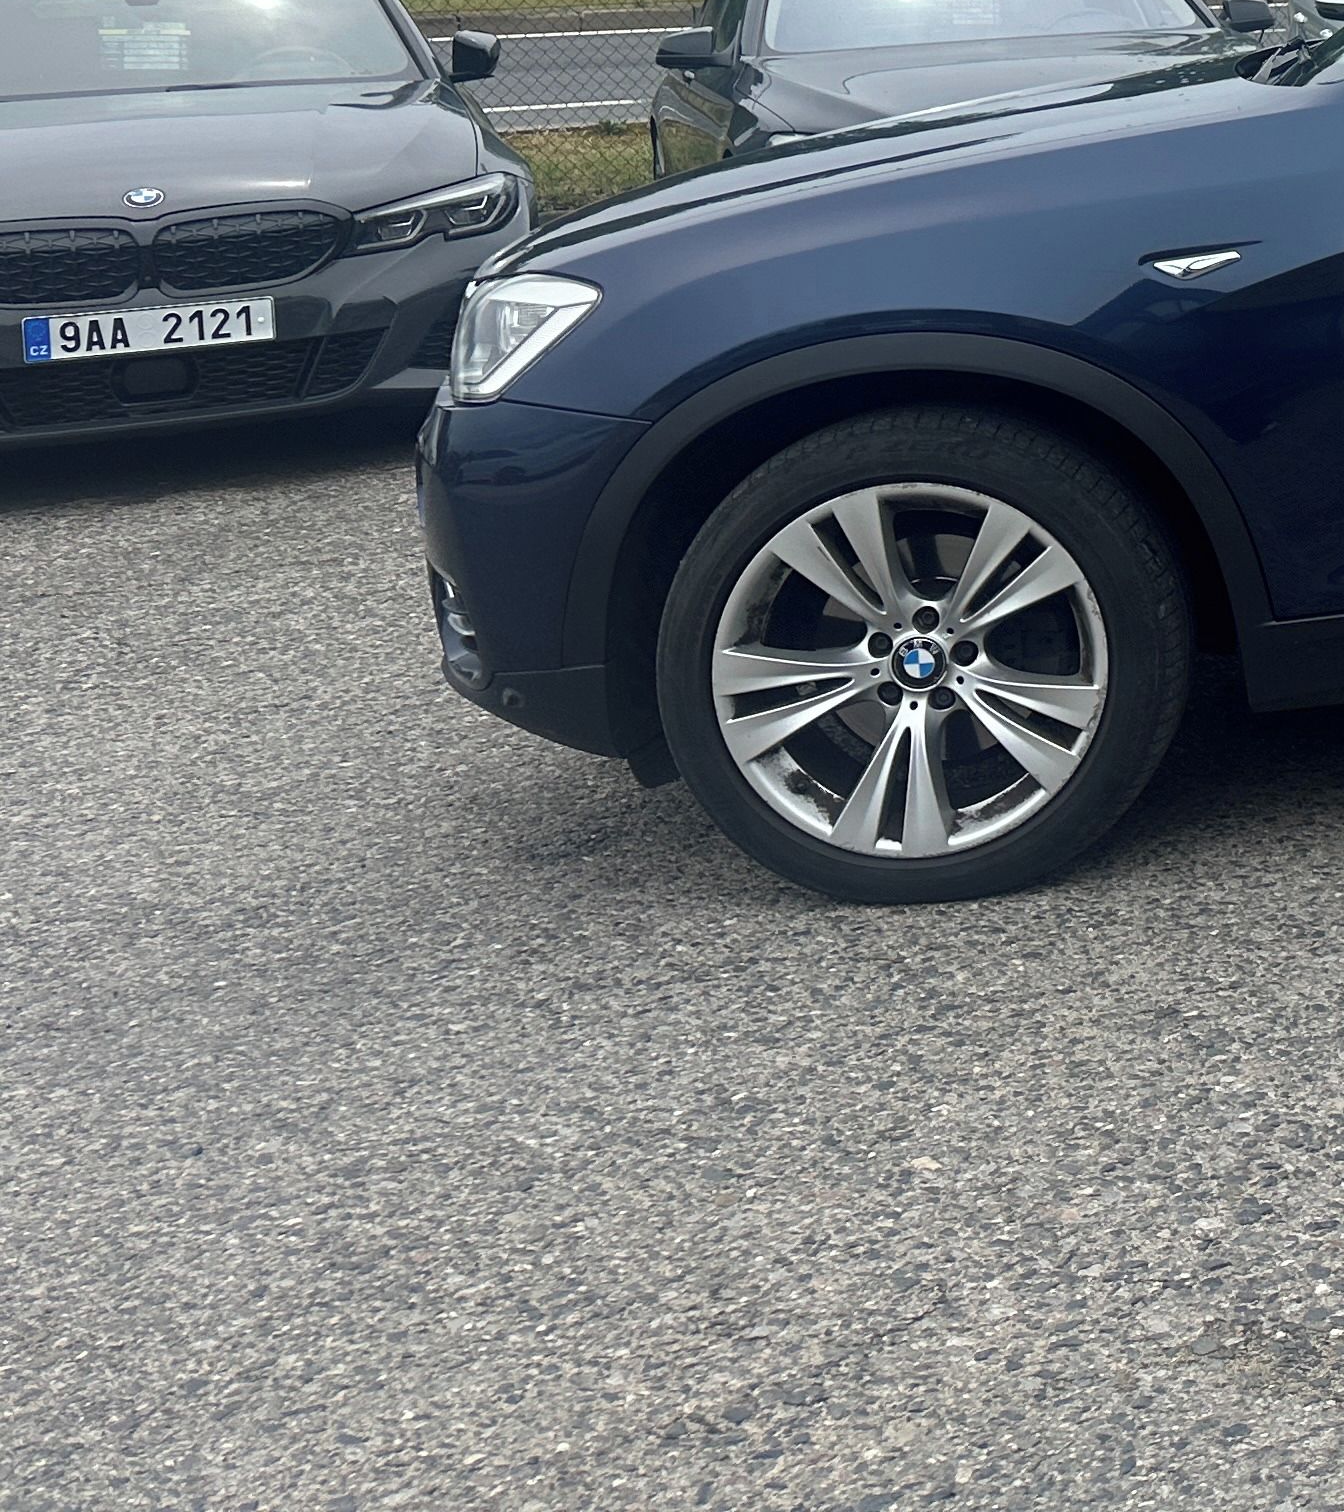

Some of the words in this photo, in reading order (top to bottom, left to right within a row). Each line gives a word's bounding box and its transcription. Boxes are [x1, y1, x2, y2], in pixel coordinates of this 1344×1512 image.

[59, 317, 131, 353] 9AA
[162, 305, 252, 344] 2121
[29, 344, 49, 356] CZ
